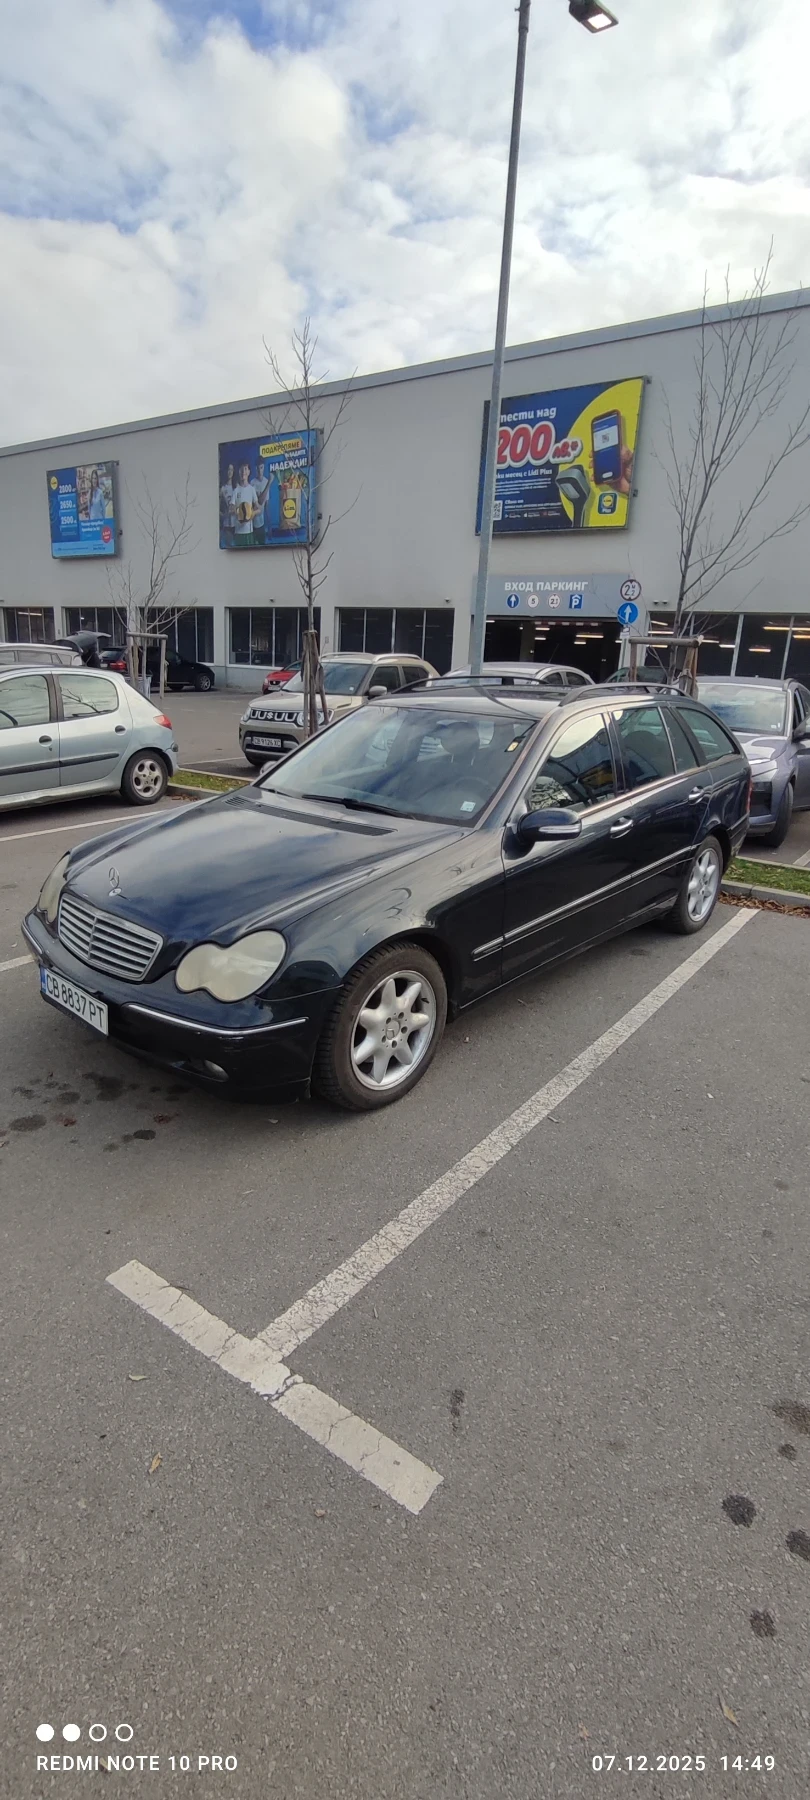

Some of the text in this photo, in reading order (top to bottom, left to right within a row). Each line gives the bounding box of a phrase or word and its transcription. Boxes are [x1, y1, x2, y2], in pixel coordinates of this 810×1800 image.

[500, 407, 557, 423] пести над
[270, 458, 307, 472] НАДЕЖДИ!
[539, 468, 552, 476] Plus
[504, 581, 588, 593] ВХОД ПАРКИНГ
[47, 974, 105, 1028] CB 8837 PT
